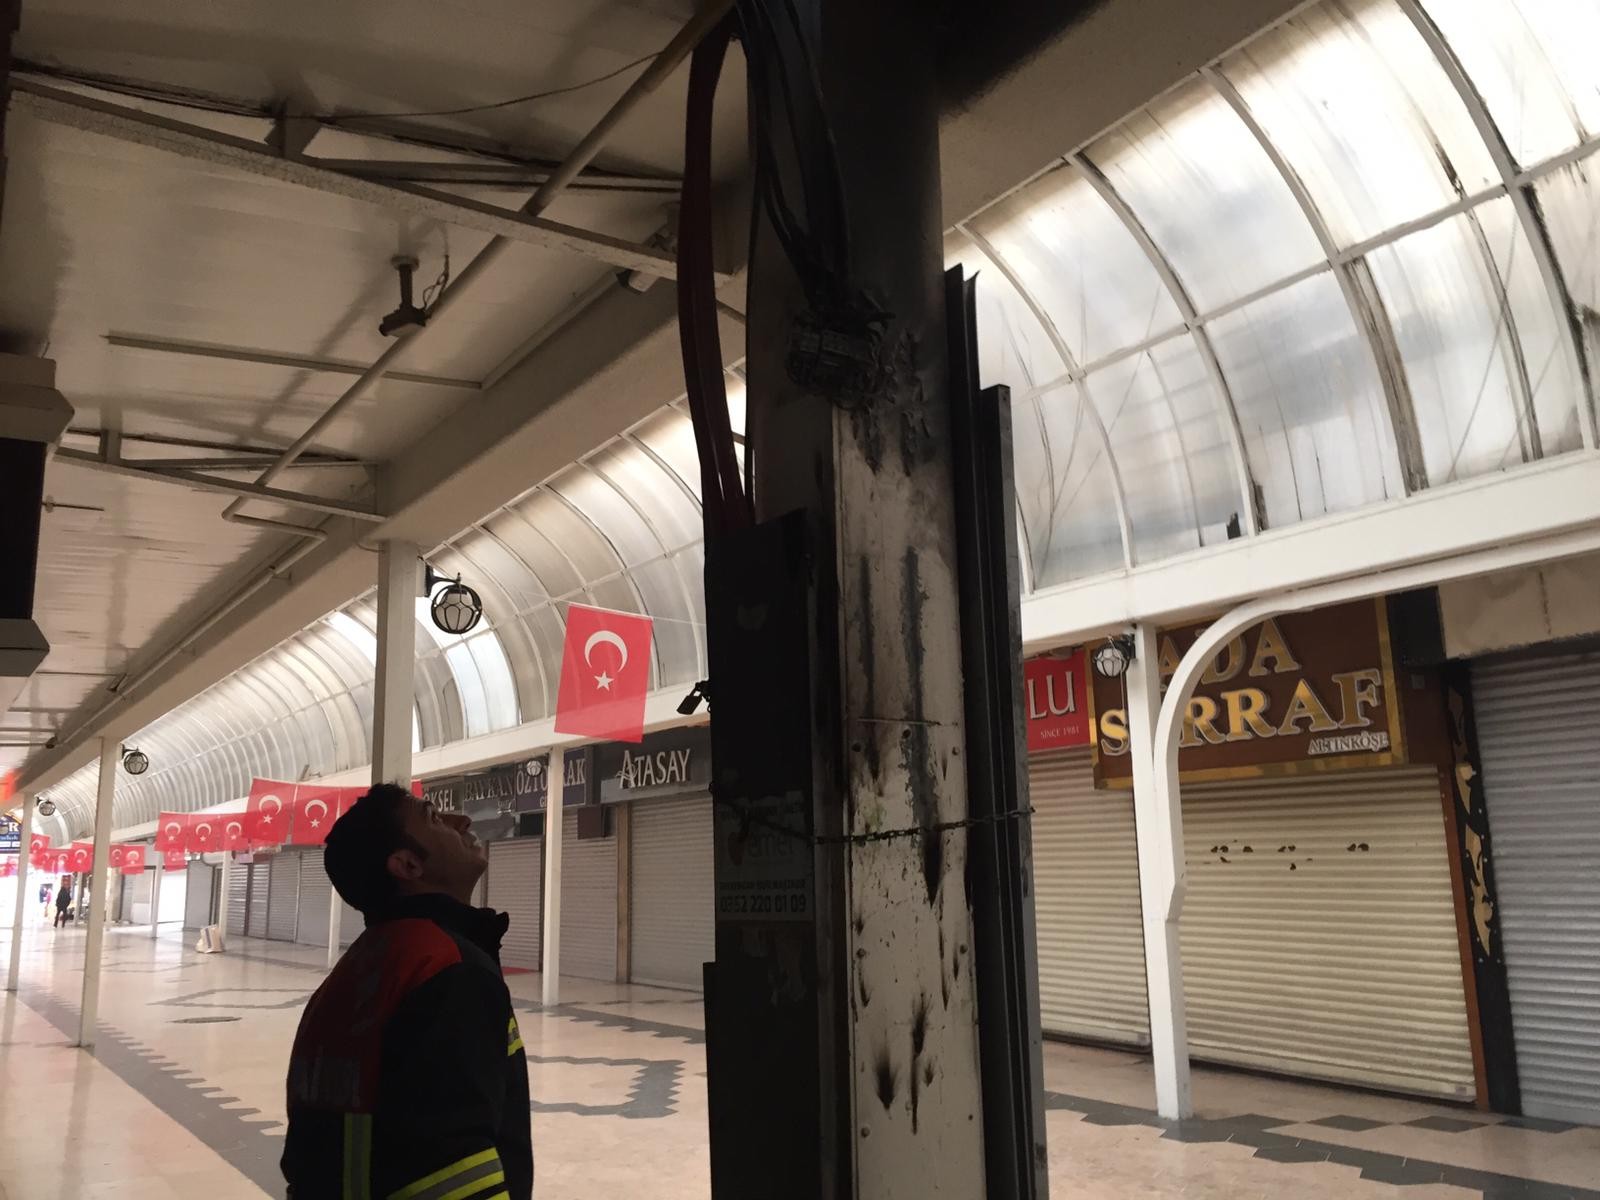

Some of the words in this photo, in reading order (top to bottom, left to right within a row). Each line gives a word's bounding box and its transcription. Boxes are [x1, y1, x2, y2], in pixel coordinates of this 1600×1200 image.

[1101, 668, 1382, 756] SRRAF
[617, 748, 691, 789] ATASAY
[751, 894, 771, 912] 220
